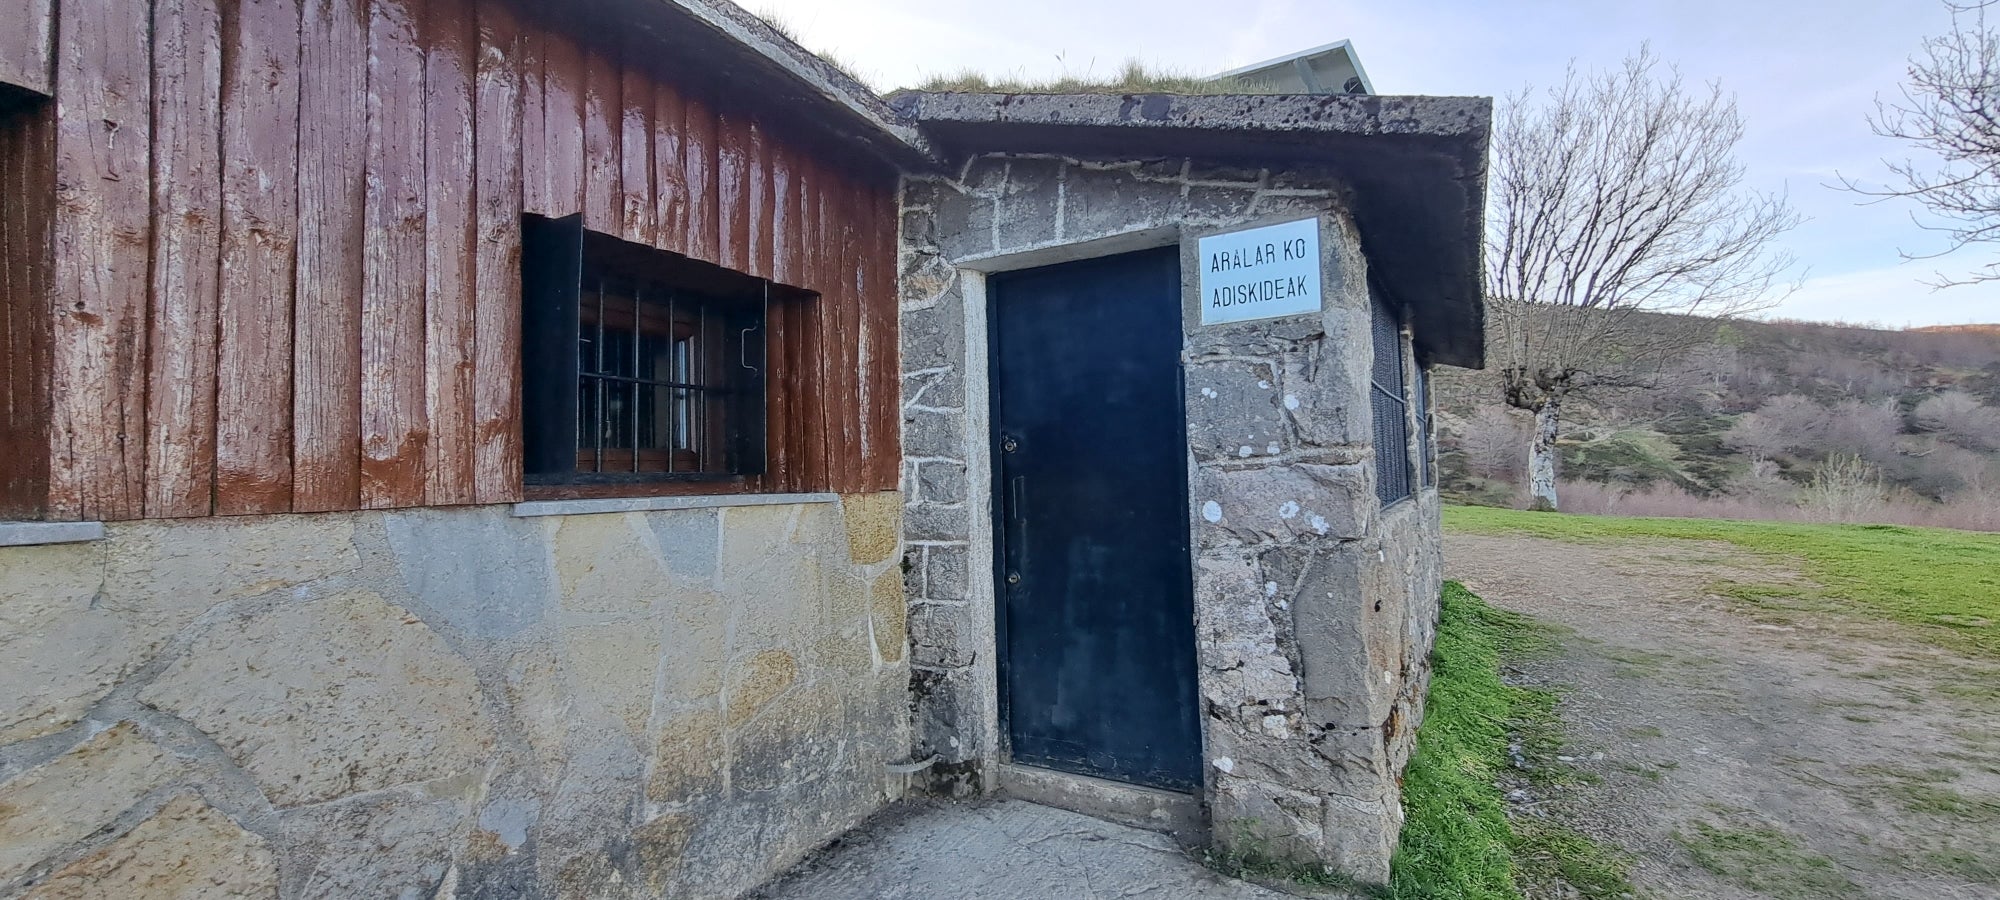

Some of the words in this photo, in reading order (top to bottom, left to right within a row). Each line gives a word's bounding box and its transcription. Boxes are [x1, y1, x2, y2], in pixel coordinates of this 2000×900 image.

[1211, 243, 1276, 273] ARALAR
[1283, 238, 1306, 262] KO
[1212, 274, 1308, 308] ADISKIDEAK
